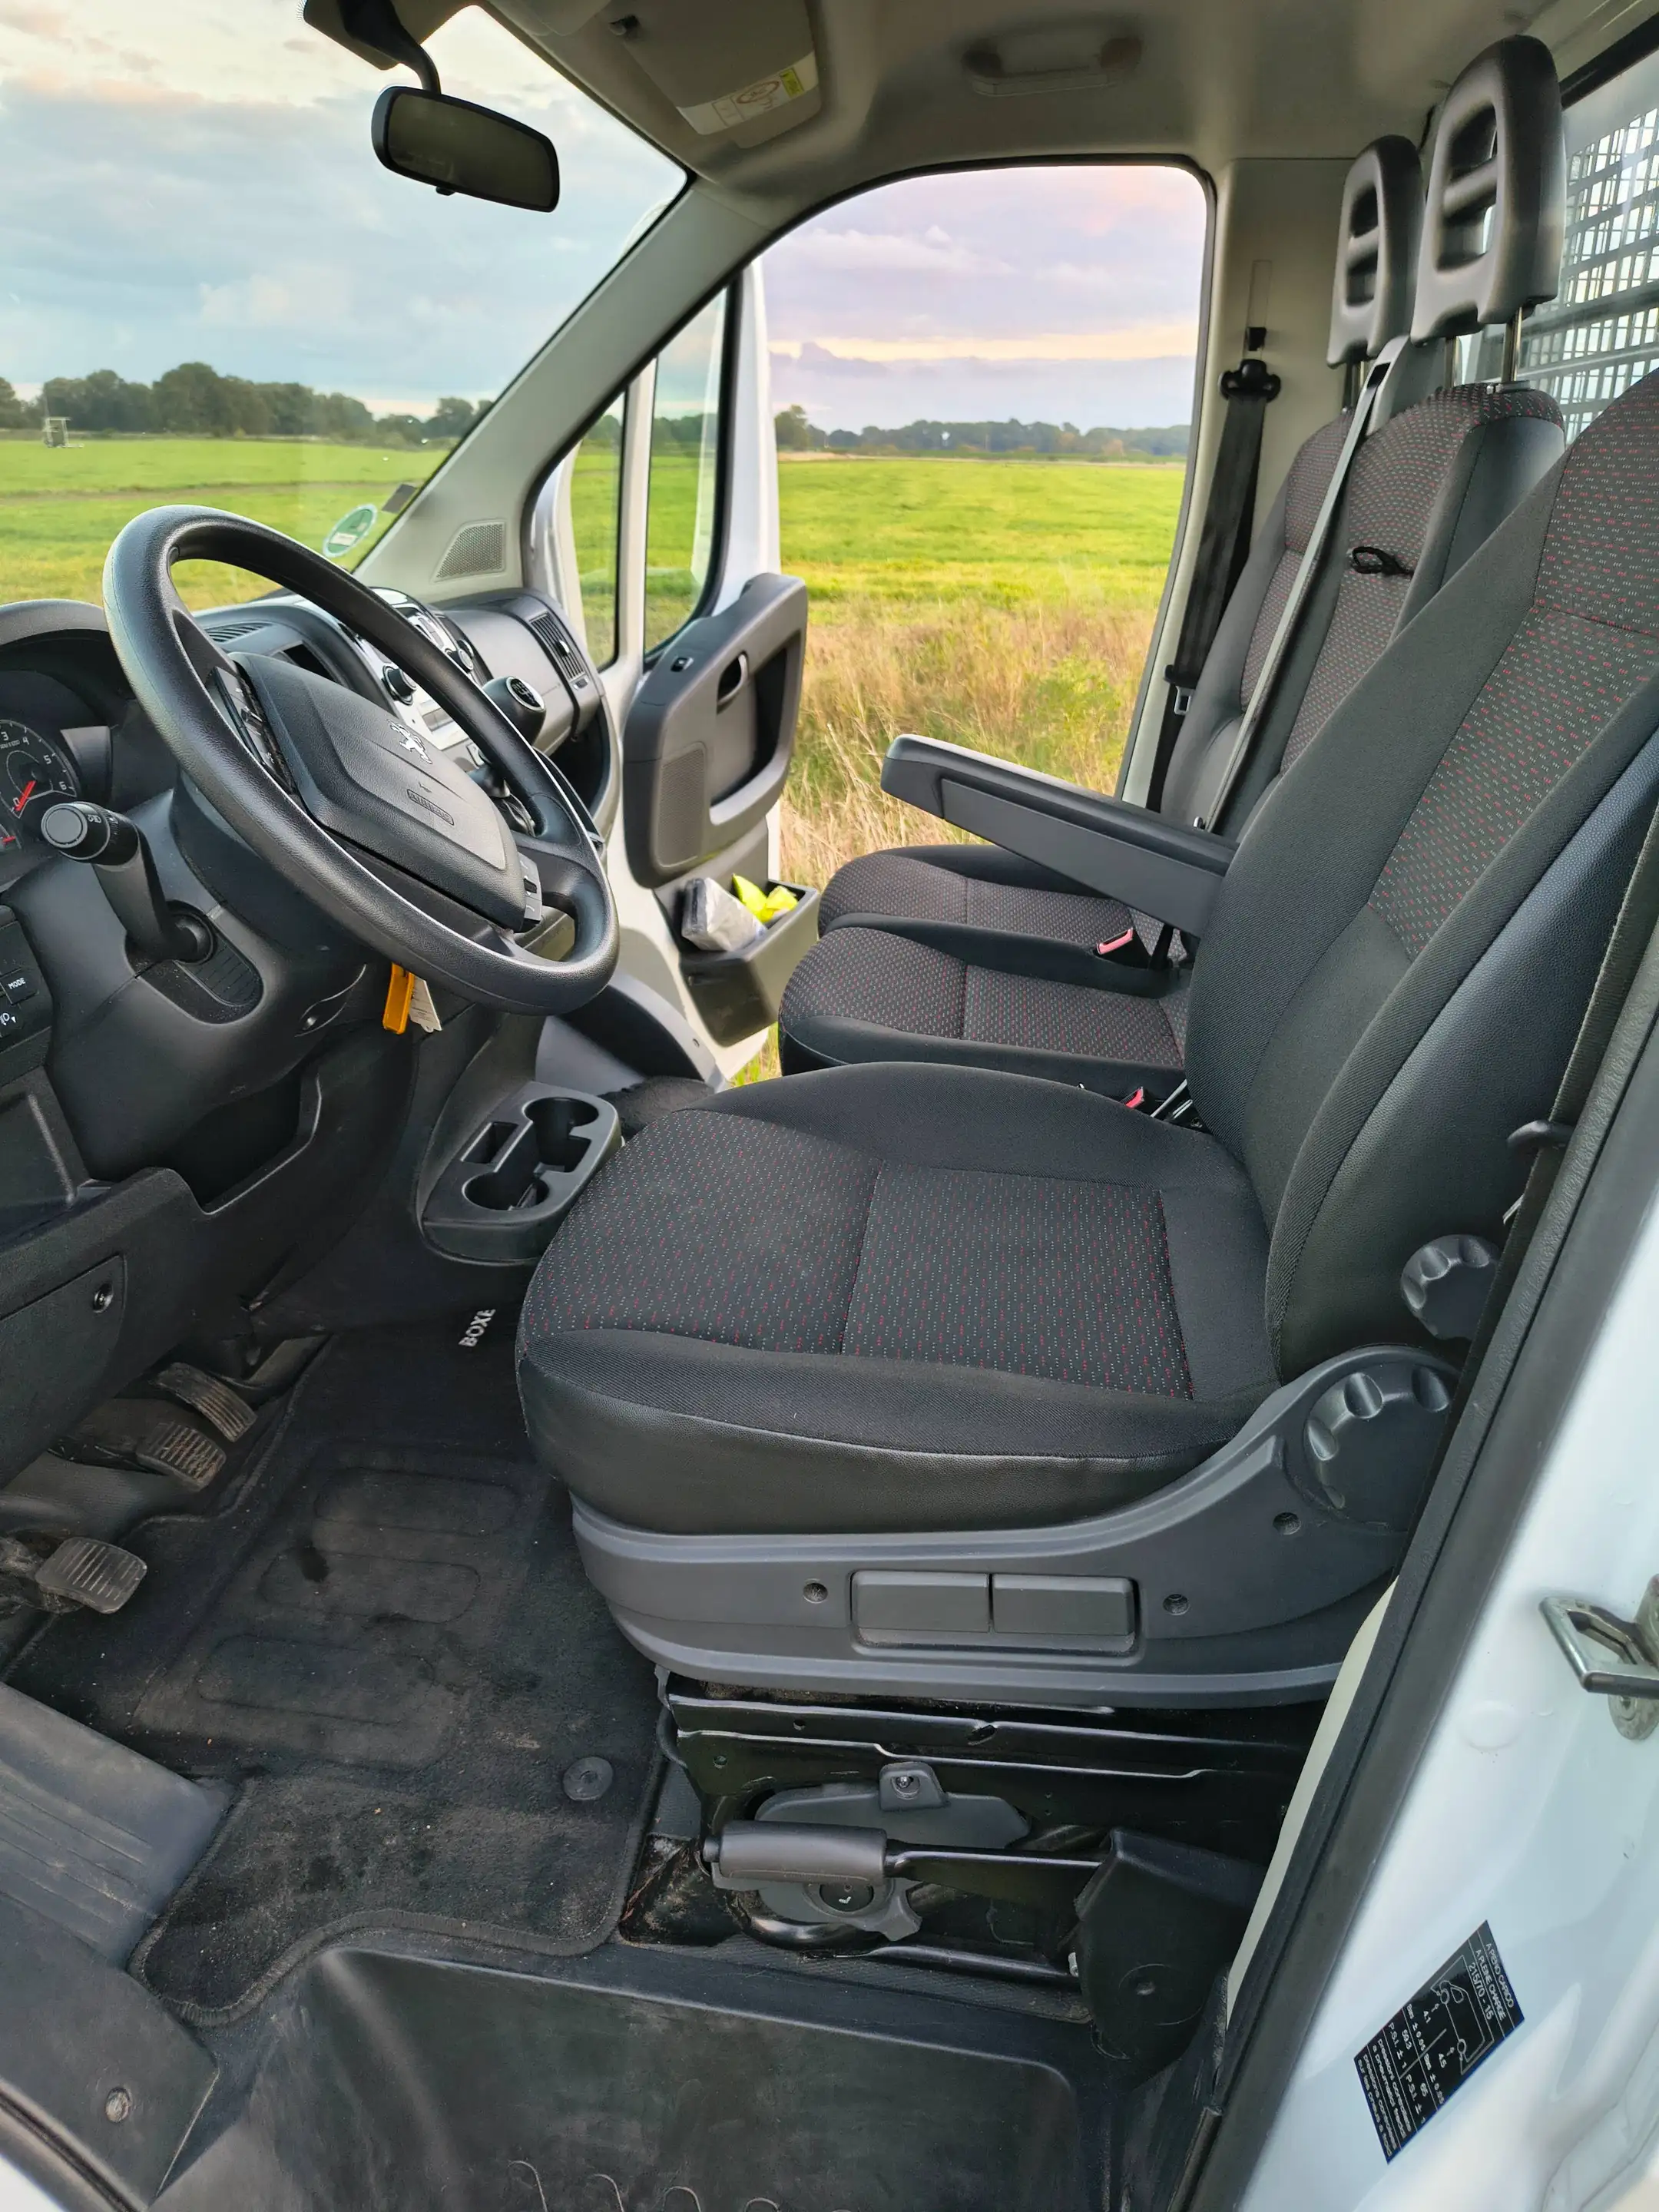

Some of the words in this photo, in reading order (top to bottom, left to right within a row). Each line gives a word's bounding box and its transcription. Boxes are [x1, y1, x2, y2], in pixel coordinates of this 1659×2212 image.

[1, 731, 9, 741] 3
[22, 736, 30, 746] 4
[43, 754, 52, 765] 5
[58, 781, 68, 791] 6
[8, 977, 26, 990] MODE
[1485, 1942, 1492, 1951] A
[1475, 1949, 1482, 1958] A
[1468, 1962, 1485, 1998] 215/70
[1485, 2004, 1495, 2020] 15
[1423, 2011, 1432, 2024] 4.1
[1401, 2028, 1412, 2050] 59.3
[1438, 2053, 1447, 2068] 4.5
